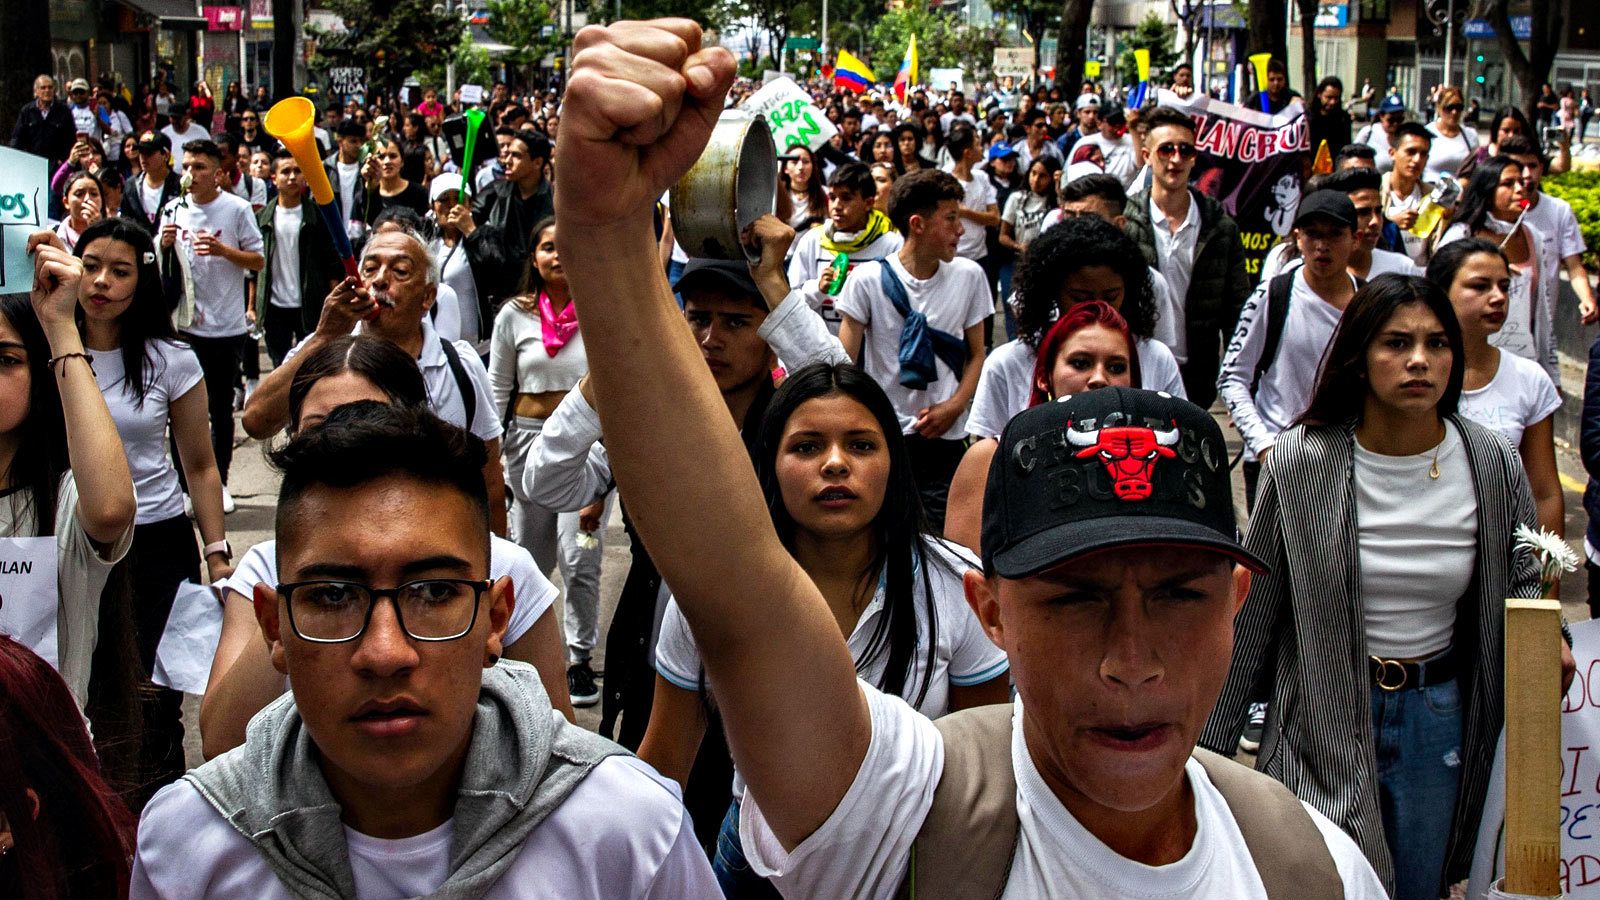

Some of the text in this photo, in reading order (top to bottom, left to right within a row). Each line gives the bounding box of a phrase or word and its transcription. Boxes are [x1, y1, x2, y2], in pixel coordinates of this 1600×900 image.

[332, 83, 365, 94] VIDA
[767, 99, 809, 133] RZA
[1238, 113, 1310, 163] CRUZ
[0, 192, 30, 219] OS
[1012, 411, 1219, 473] CHGO
